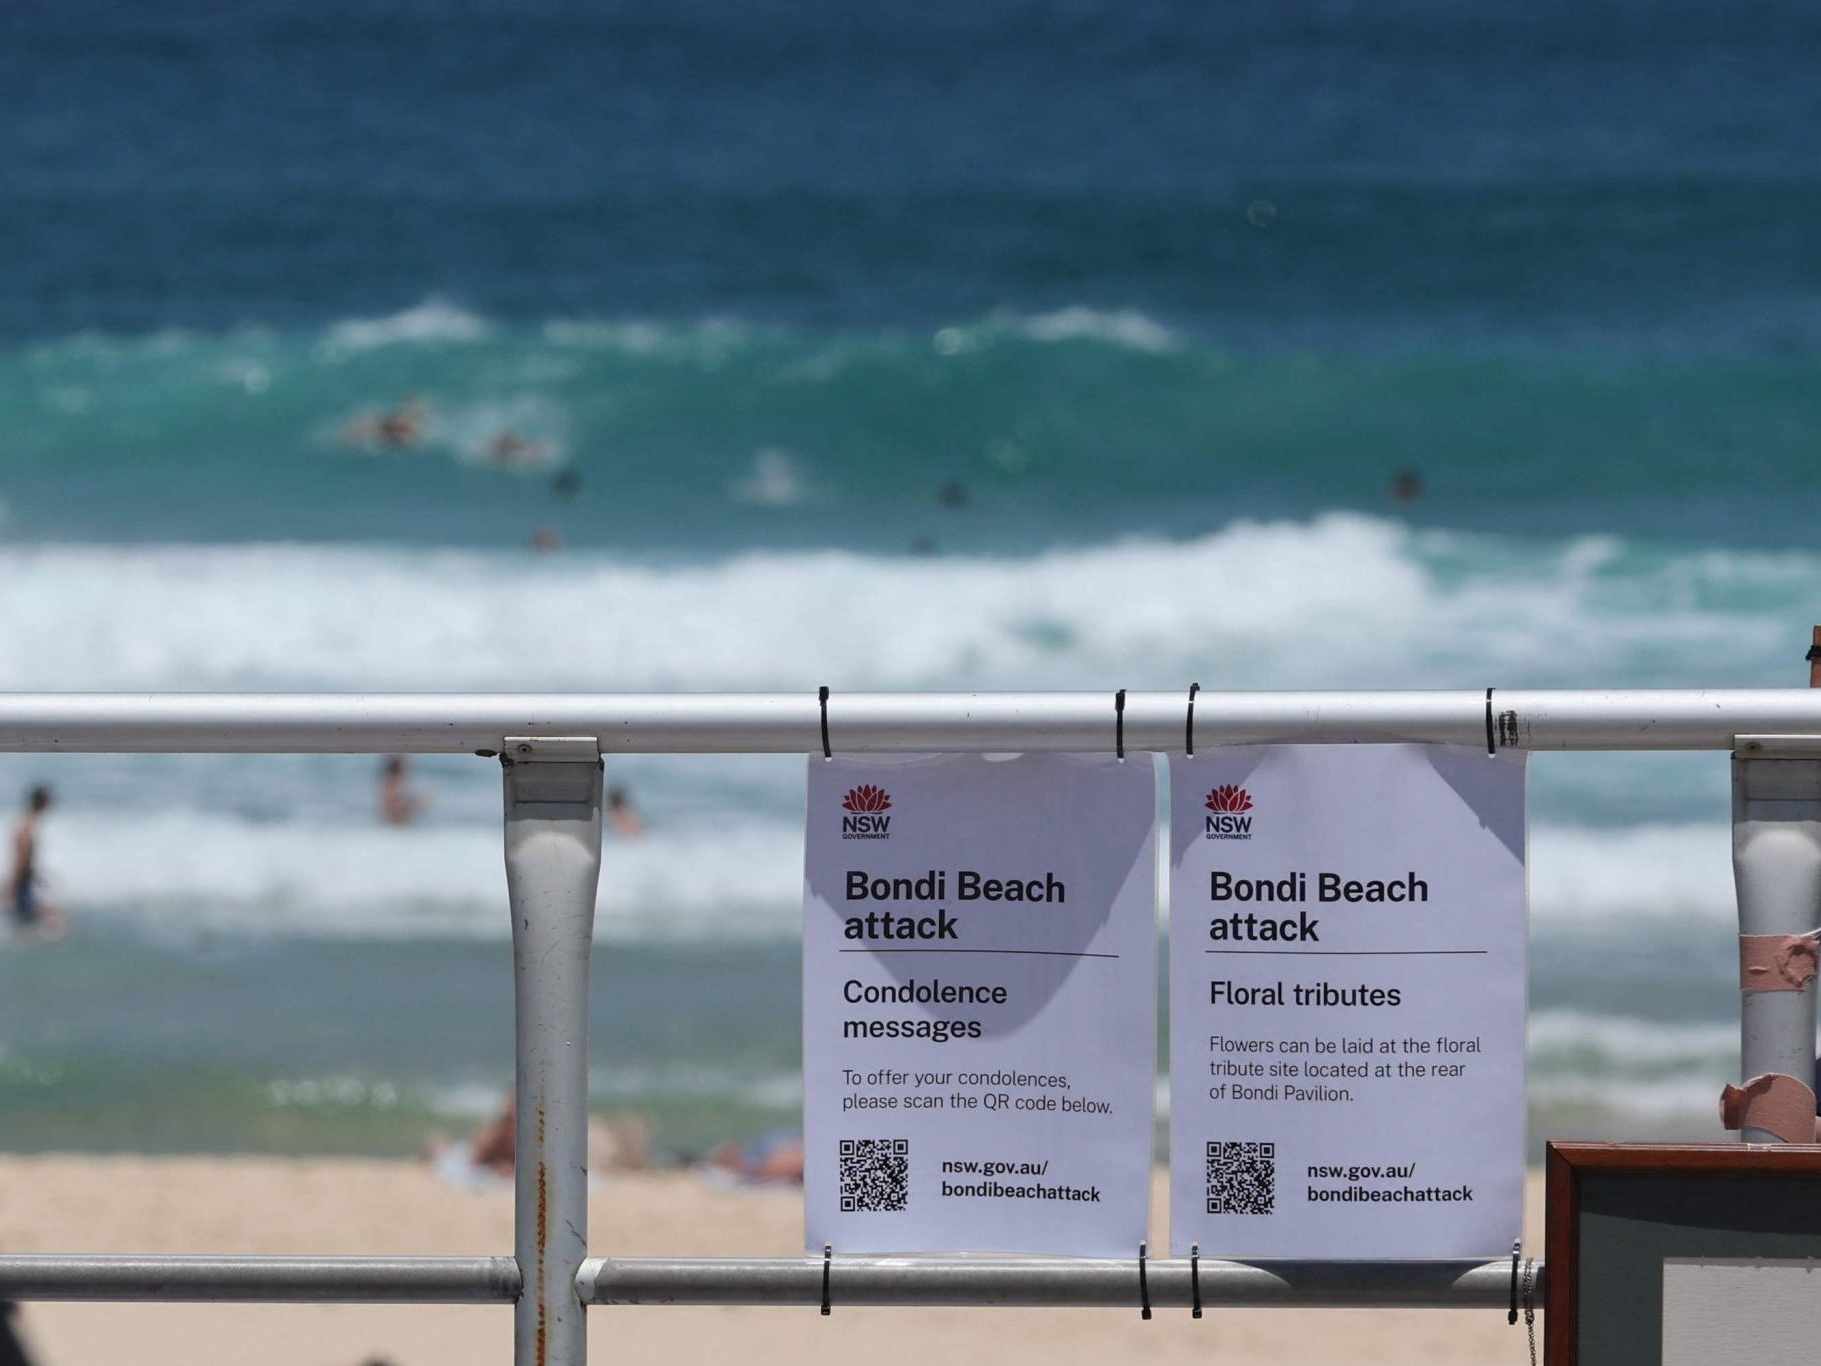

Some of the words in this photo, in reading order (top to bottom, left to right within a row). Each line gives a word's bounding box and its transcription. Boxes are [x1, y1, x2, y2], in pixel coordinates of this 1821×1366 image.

[842, 815, 891, 833] NSW
[1205, 815, 1253, 833] NSW
[845, 869, 946, 901] Bondi
[957, 870, 1066, 904] Beach
[1210, 871, 1307, 903] Bondi
[1318, 871, 1429, 903] Beach
[844, 909, 959, 940] attack
[1209, 910, 1320, 943] attack
[843, 978, 1008, 1005] Condolence
[1210, 980, 1285, 1006] Floral
[1292, 981, 1402, 1007] tributes
[843, 1019, 982, 1044] messages
[1209, 1035, 1275, 1054] Flowers
[1278, 1040, 1310, 1054] can
[1314, 1036, 1337, 1054] be
[1342, 1036, 1374, 1055] laid
[1378, 1038, 1397, 1055] at
[1401, 1036, 1431, 1054] the
[1435, 1035, 1482, 1054] floral
[841, 1069, 862, 1086] To
[866, 1068, 911, 1086] offer
[913, 1072, 954, 1089] your
[957, 1068, 1071, 1091] condolences,
[1209, 1059, 1265, 1077] tribute
[1268, 1060, 1300, 1078] site
[1303, 1060, 1369, 1078] located
[1374, 1062, 1393, 1079] at
[1396, 1060, 1427, 1078] the
[1430, 1064, 1467, 1078] rear
[842, 1092, 899, 1113] please
[903, 1095, 944, 1109] scan
[949, 1091, 979, 1110] the
[983, 1092, 1010, 1112] QR
[1014, 1093, 1057, 1112] code
[1061, 1095, 1113, 1115] below.
[1209, 1083, 1228, 1100] of
[1231, 1083, 1279, 1101] Bondi
[1283, 1084, 1354, 1102] Pavilion.
[941, 1159, 1049, 1178] nsw.gov.au/
[1307, 1161, 1416, 1182] nsw.gov.au/
[941, 1180, 1101, 1203] bondibeachattack
[1307, 1184, 1474, 1203] bondibeachattack
